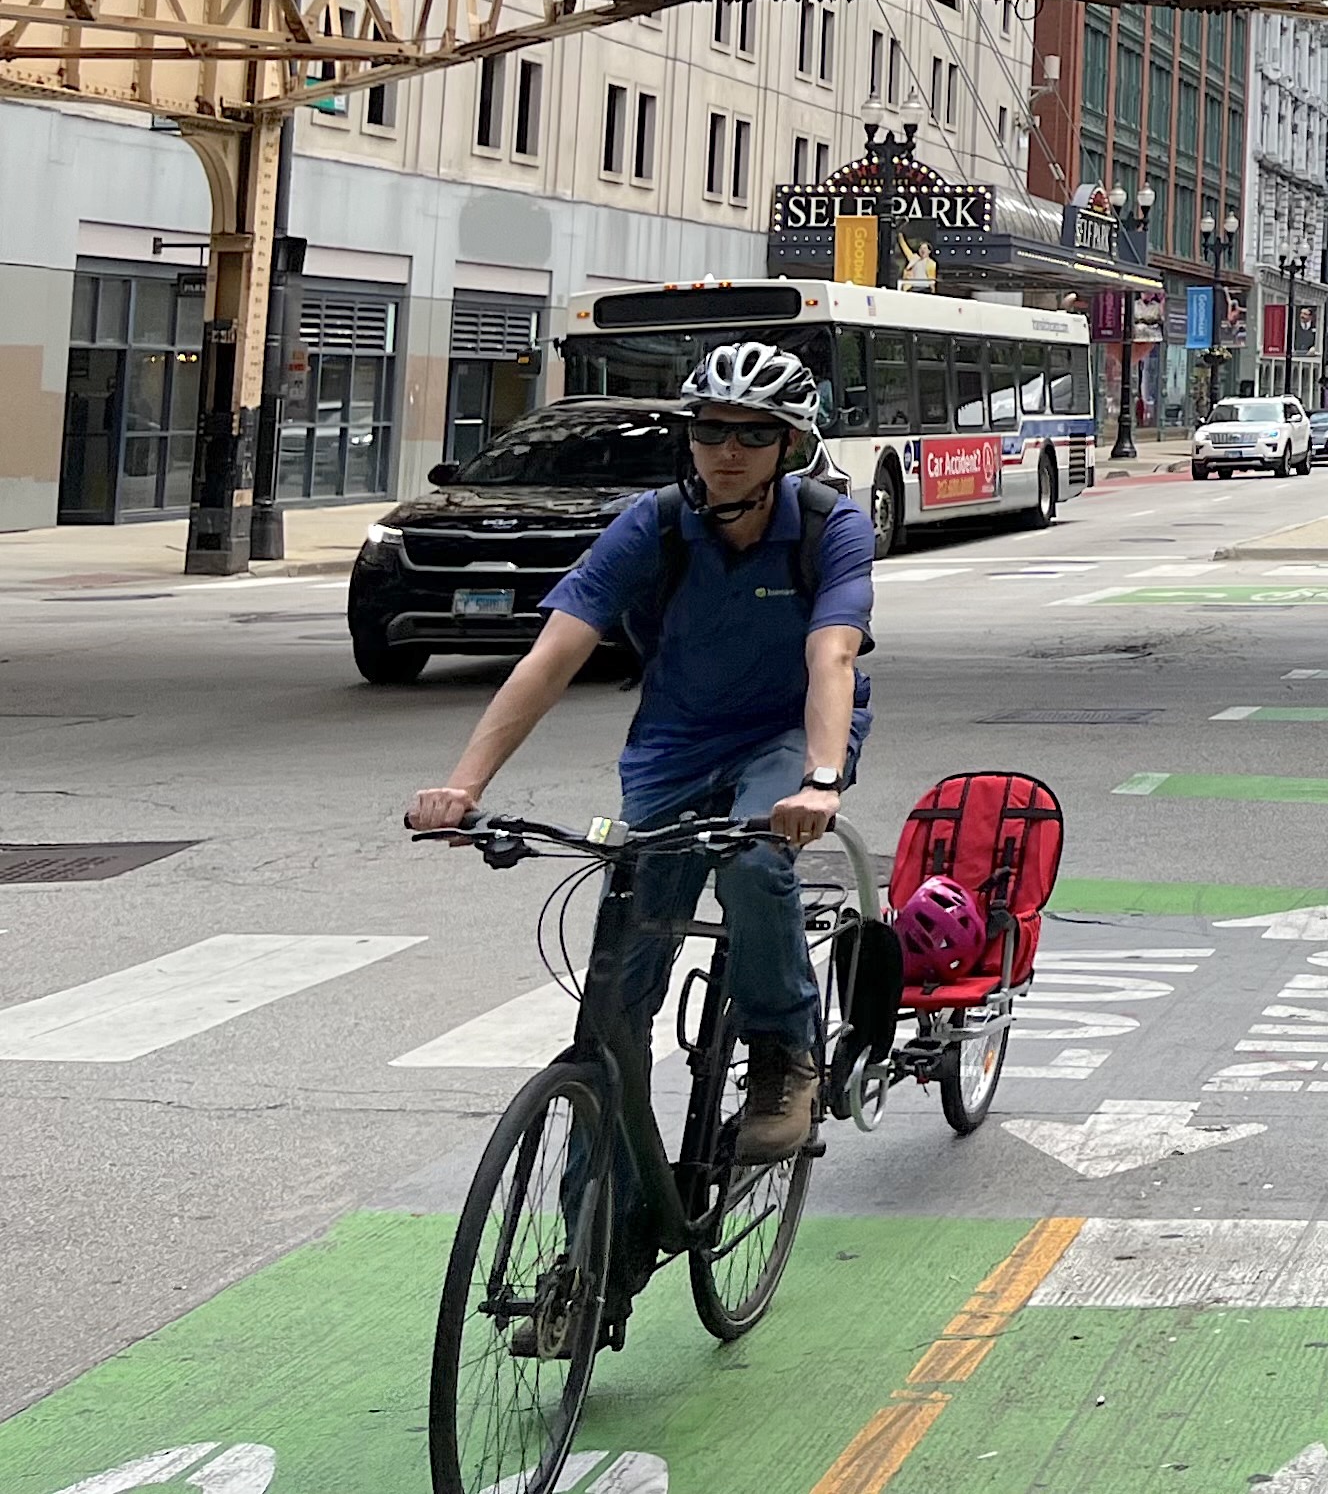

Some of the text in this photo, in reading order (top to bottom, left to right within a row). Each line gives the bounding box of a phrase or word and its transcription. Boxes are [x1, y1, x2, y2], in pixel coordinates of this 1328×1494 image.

[787, 196, 980, 228] SELF PARK
[927, 447, 981, 478] Car Accident?
